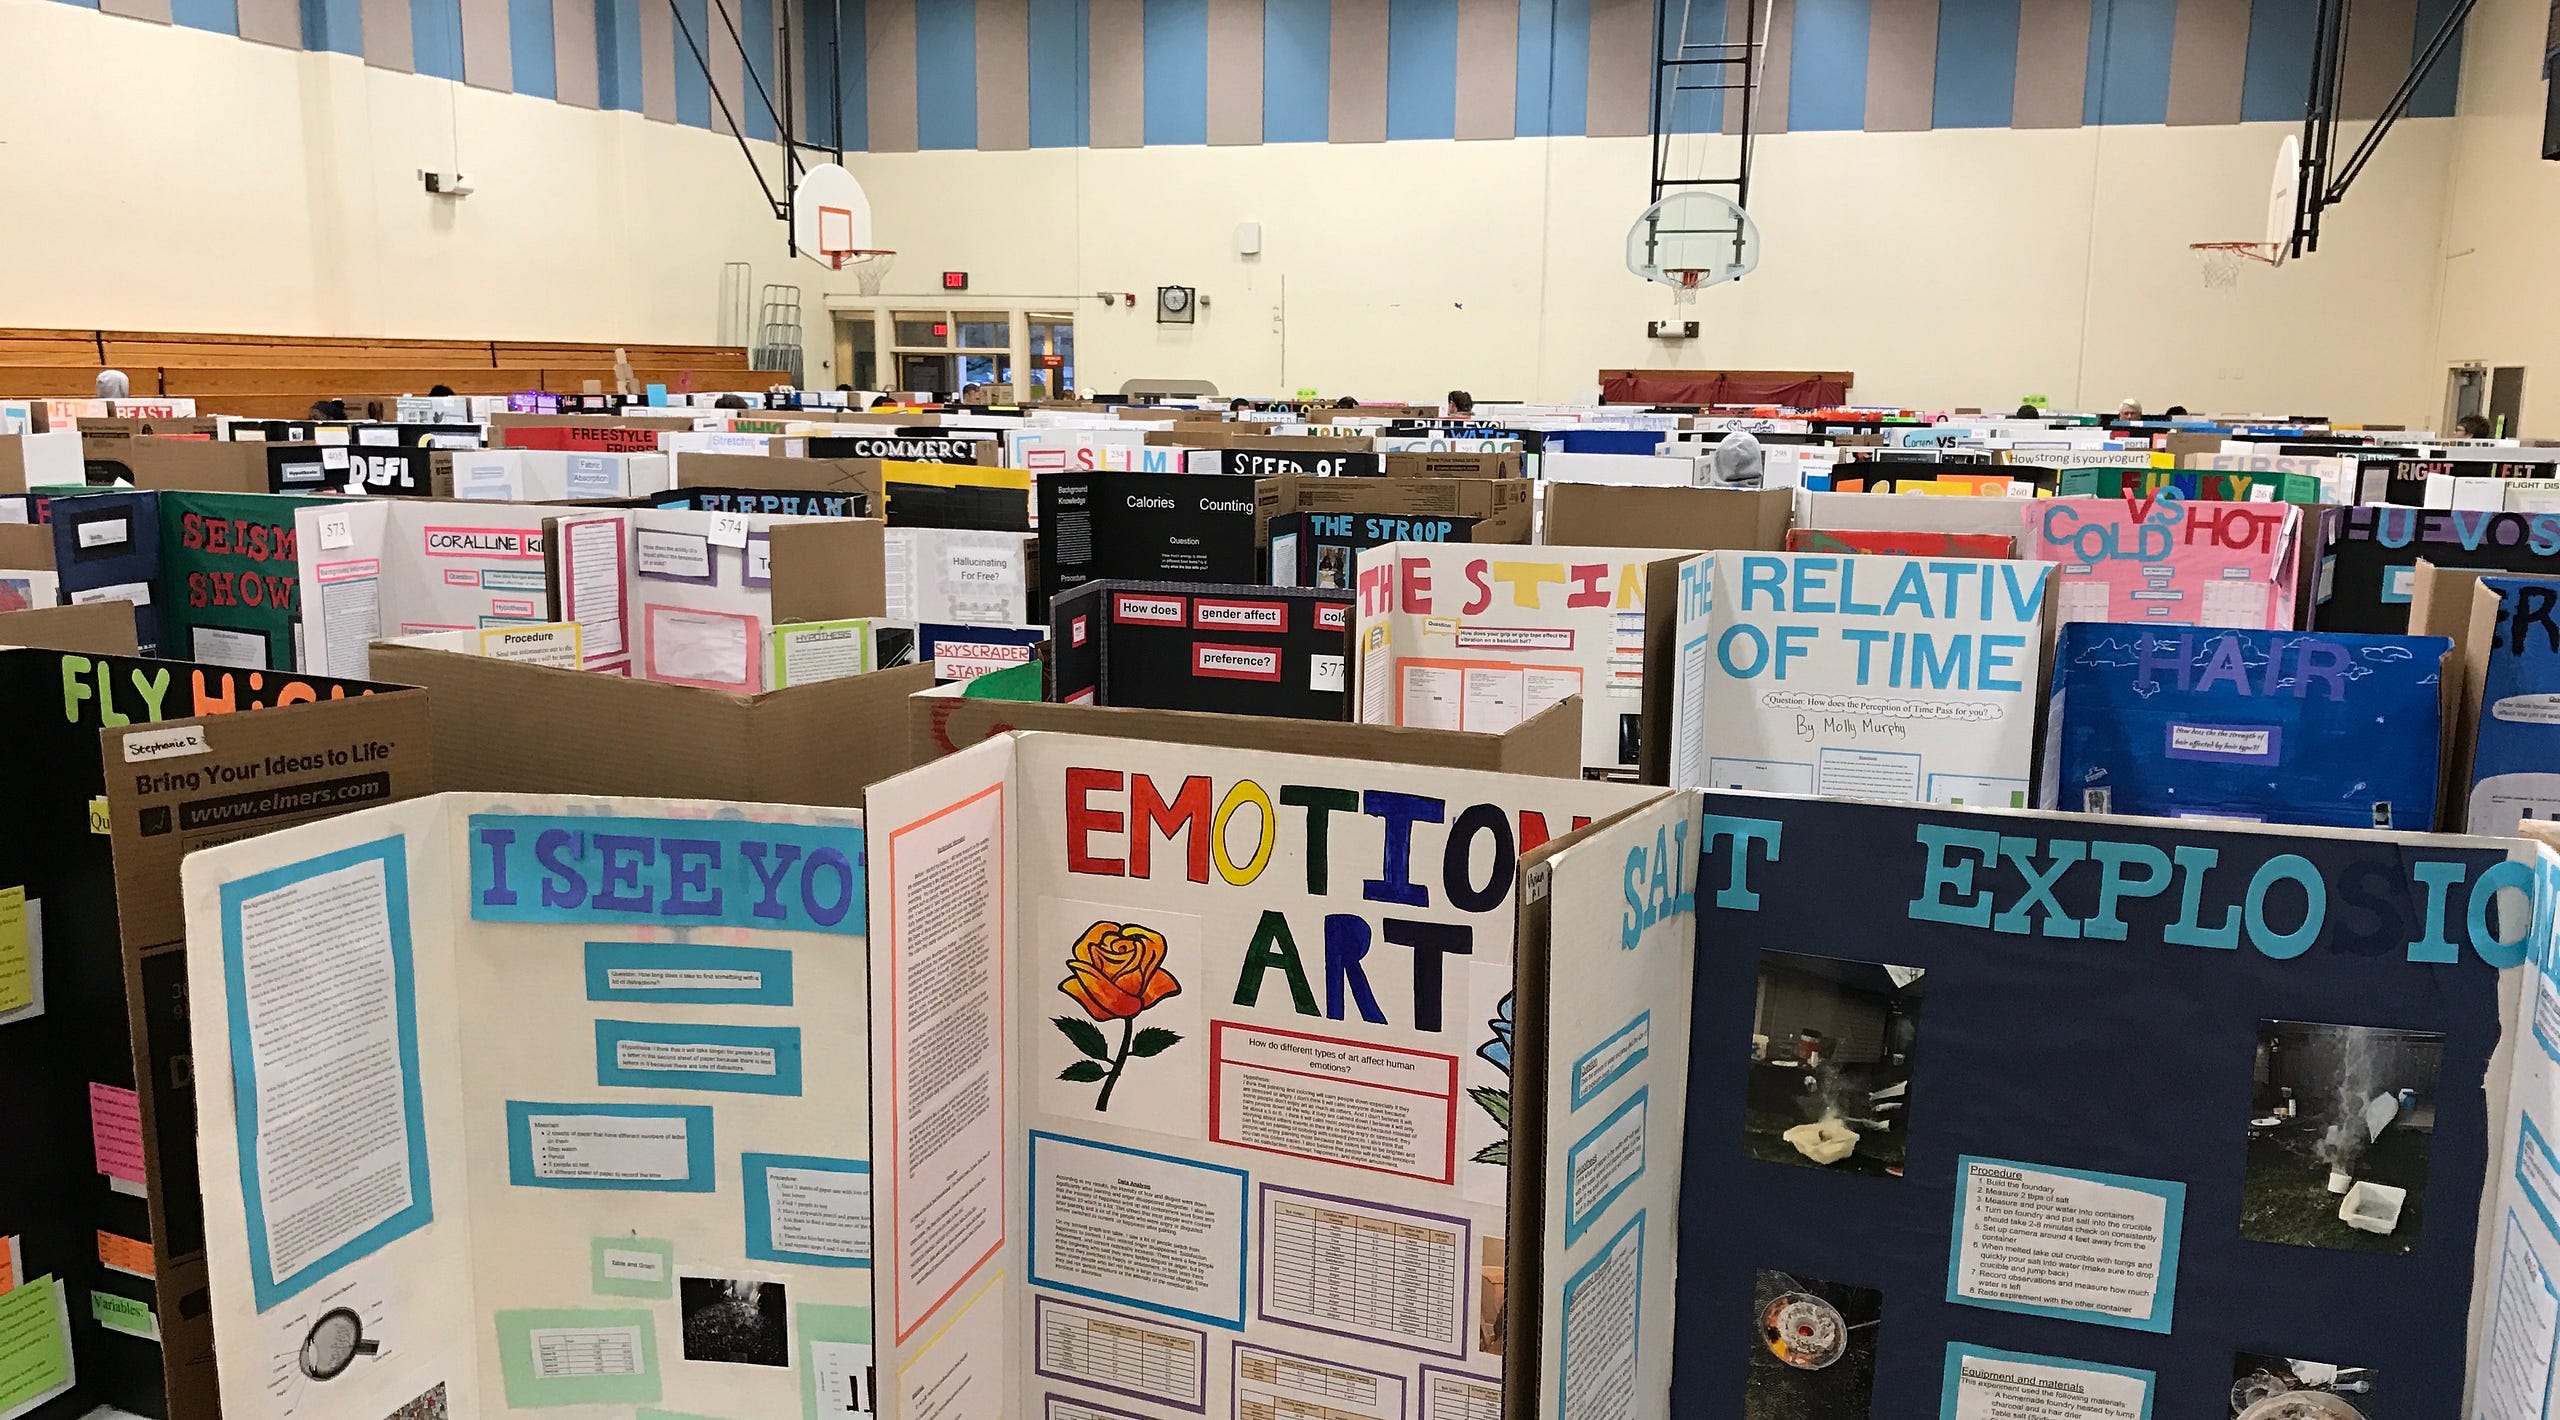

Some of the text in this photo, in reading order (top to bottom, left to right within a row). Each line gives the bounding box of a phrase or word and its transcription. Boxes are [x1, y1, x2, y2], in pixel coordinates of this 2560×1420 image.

[946, 273, 964, 287] EXIT
[572, 428, 653, 442] FREESTYLE
[1308, 427, 1362, 437] MOLDY
[1316, 458, 1347, 477] OF
[2011, 453, 2151, 467] How strong is your yogurt?
[350, 455, 414, 488] DEFL
[2397, 463, 2455, 481] RIGHT
[2011, 487, 2028, 497] 260
[2121, 471, 2252, 501] FUNKY
[2506, 481, 2540, 491] FLIGHT
[1126, 495, 1254, 514] Calories Counting
[326, 523, 346, 537] 573
[718, 518, 742, 533] 574
[1311, 515, 1453, 544] THE STROOP
[2044, 505, 2173, 563] COLD
[2184, 507, 2283, 554] HOT
[183, 512, 297, 562] SEISM
[430, 534, 519, 550] CORALLINE
[1170, 536, 1200, 546] Question
[953, 556, 1008, 569] Hallucinating
[961, 571, 1000, 581] For Free?
[188, 571, 302, 613] SHOW
[1359, 557, 1433, 618] THE
[1682, 556, 1715, 625] THE
[1741, 556, 2053, 623] RELATIV
[1123, 602, 1148, 614] How
[1151, 603, 1178, 615] does
[1202, 608, 1242, 622] gender
[1244, 609, 1276, 621] affect
[504, 632, 554, 644] Procedure
[796, 630, 852, 644] HYPOTHESIS
[935, 643, 1029, 661] SKYSCRAPER
[1203, 652, 1271, 668] preference?
[1717, 623, 2027, 692] OF TIME
[2138, 631, 2351, 702] HAIR
[61, 655, 171, 728] FLY
[1769, 695, 1988, 718] Question: How does the Perception of Time Pass for you?
[1796, 714, 1907, 742] By Molly Murphy
[130, 738, 187, 756] Stephanie
[136, 741, 390, 796] Bring Your Ideas to Life
[191, 778, 381, 824] www.elmers.com
[1065, 766, 1592, 912] EMOTIO
[481, 828, 864, 927] I SEE YO
[1232, 909, 1473, 1033] ART
[1249, 1038, 1416, 1072] How do different types of art affect human
[1309, 1061, 1352, 1074] emotions?
[1970, 1165, 2023, 1181] Procedure
[1986, 1178, 2006, 1188] Build
[2008, 1180, 2020, 1189] the
[1986, 1187, 2019, 1198] Measure
[2046, 1194, 2054, 1202] of
[2055, 1196, 2070, 1204] salt
[1985, 1196, 2136, 1221] Measure and pour water into containers
[93, 1294, 145, 1319] Variables:
[1961, 1366, 2086, 1394] Equipment and materials
